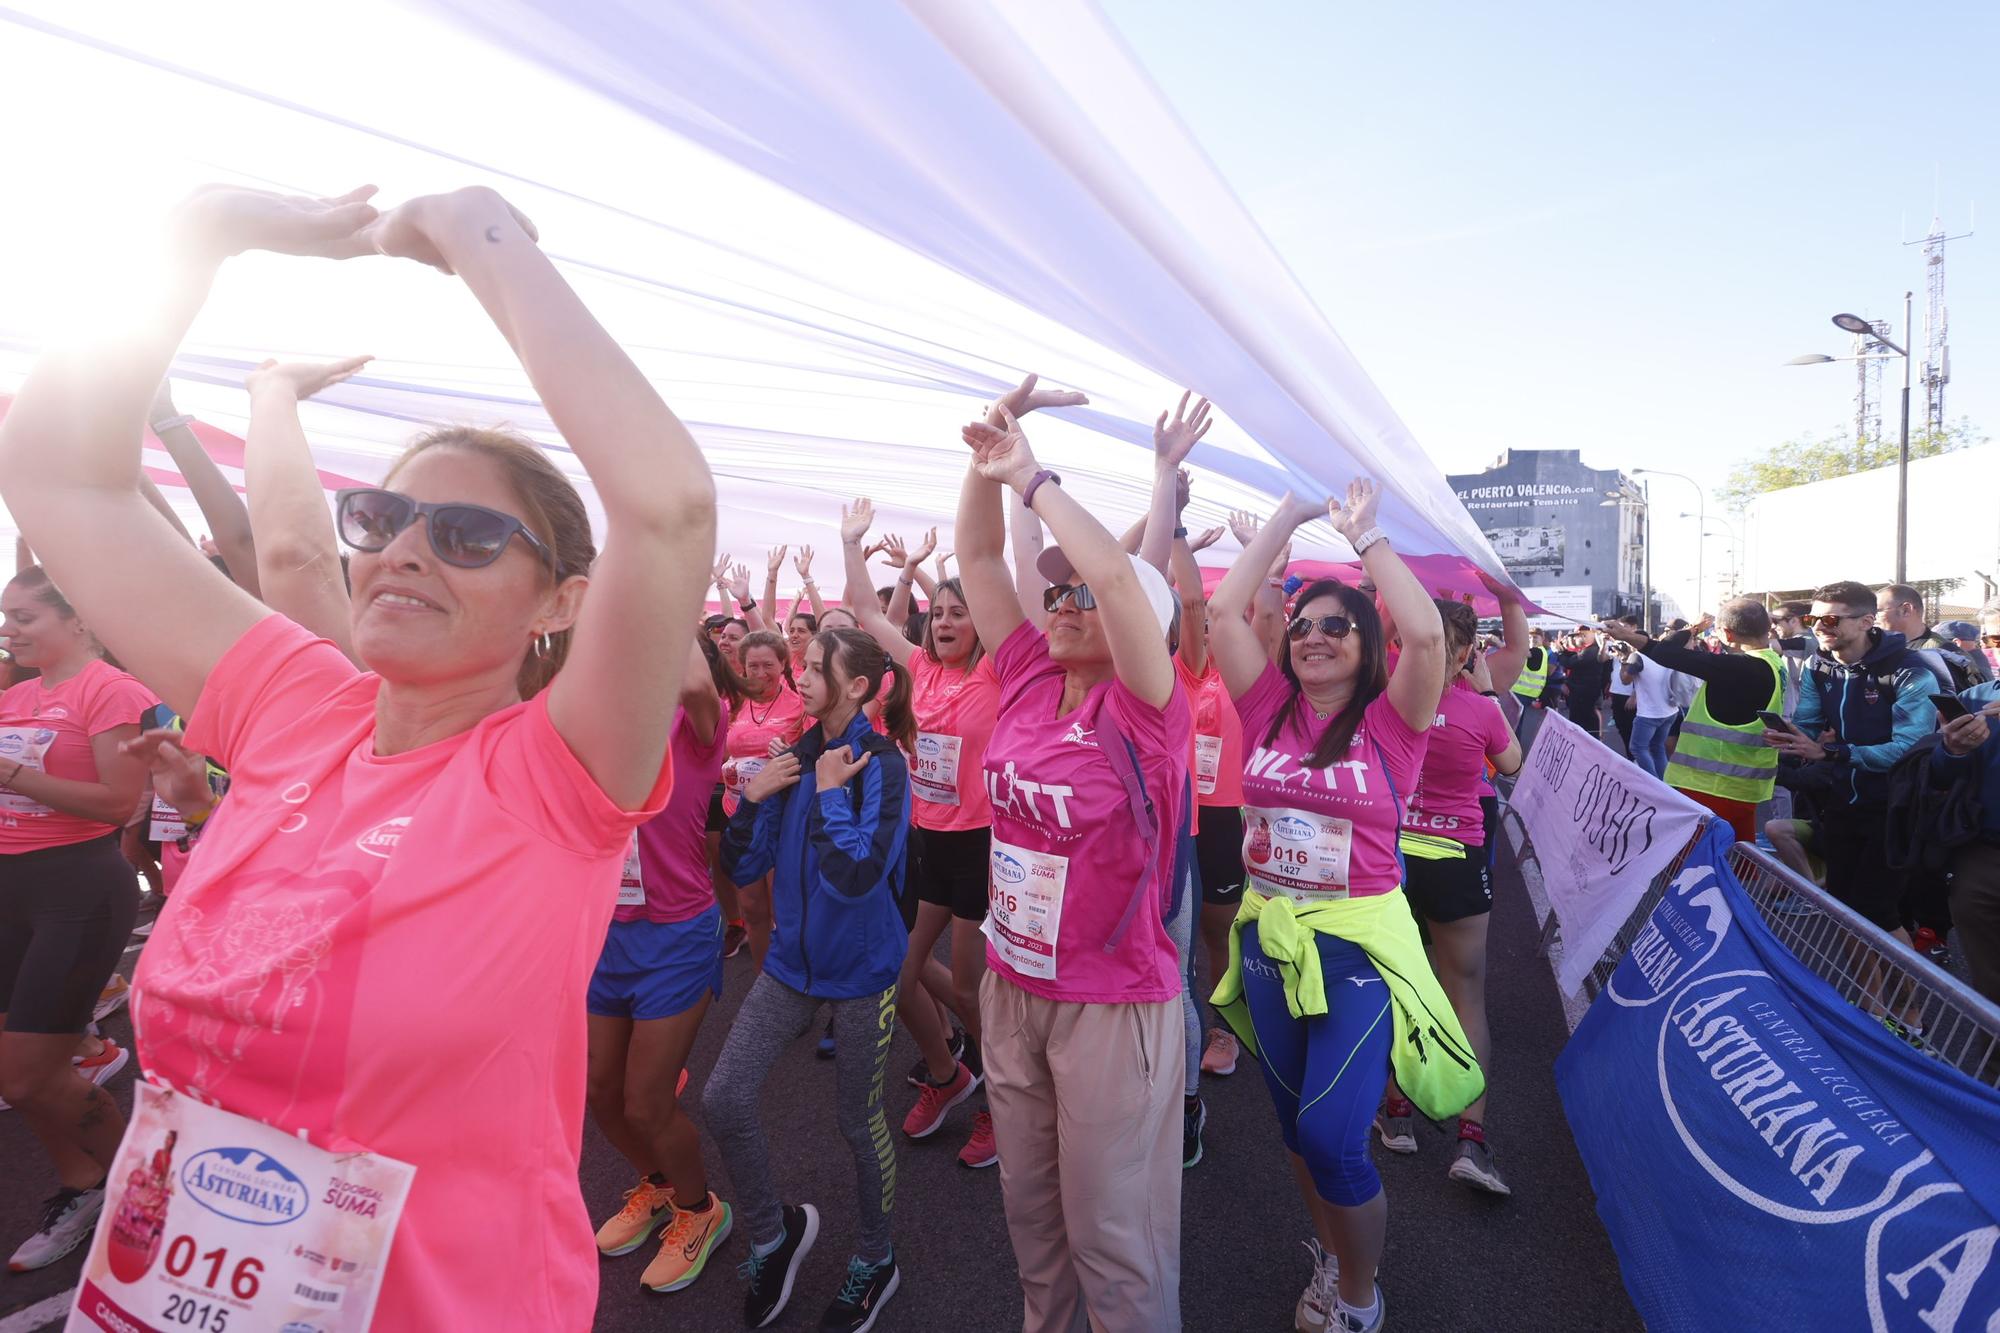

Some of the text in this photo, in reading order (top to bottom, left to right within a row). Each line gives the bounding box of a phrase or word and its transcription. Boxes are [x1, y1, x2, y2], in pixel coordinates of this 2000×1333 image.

[1471, 485, 1514, 499] PUERTO
[918, 758, 937, 771] 016
[1535, 726, 1576, 793] OYSHO
[739, 776, 752, 784] 01
[1573, 763, 1657, 876] OYSHO
[1276, 823, 1312, 838] ASTURIANA
[1320, 827, 1343, 836] SUMA
[1273, 846, 1308, 865] 016
[1030, 868, 1056, 880] SUMA
[1279, 864, 1301, 876] 1427
[1278, 877, 1287, 885] DE
[1287, 879, 1296, 887] LA
[1296, 881, 1319, 890] MUJER
[1670, 915, 1706, 953] LECHERA
[1747, 1000, 1912, 1147] CENTRAL LECHERA
[1671, 986, 1866, 1206] ASTURIANA
[187, 1161, 296, 1217] ASTURIANA
[340, 1182, 384, 1203] DORSAL
[322, 1188, 378, 1220] SUMA
[163, 1234, 266, 1301] 016
[162, 1293, 231, 1333] 2015
